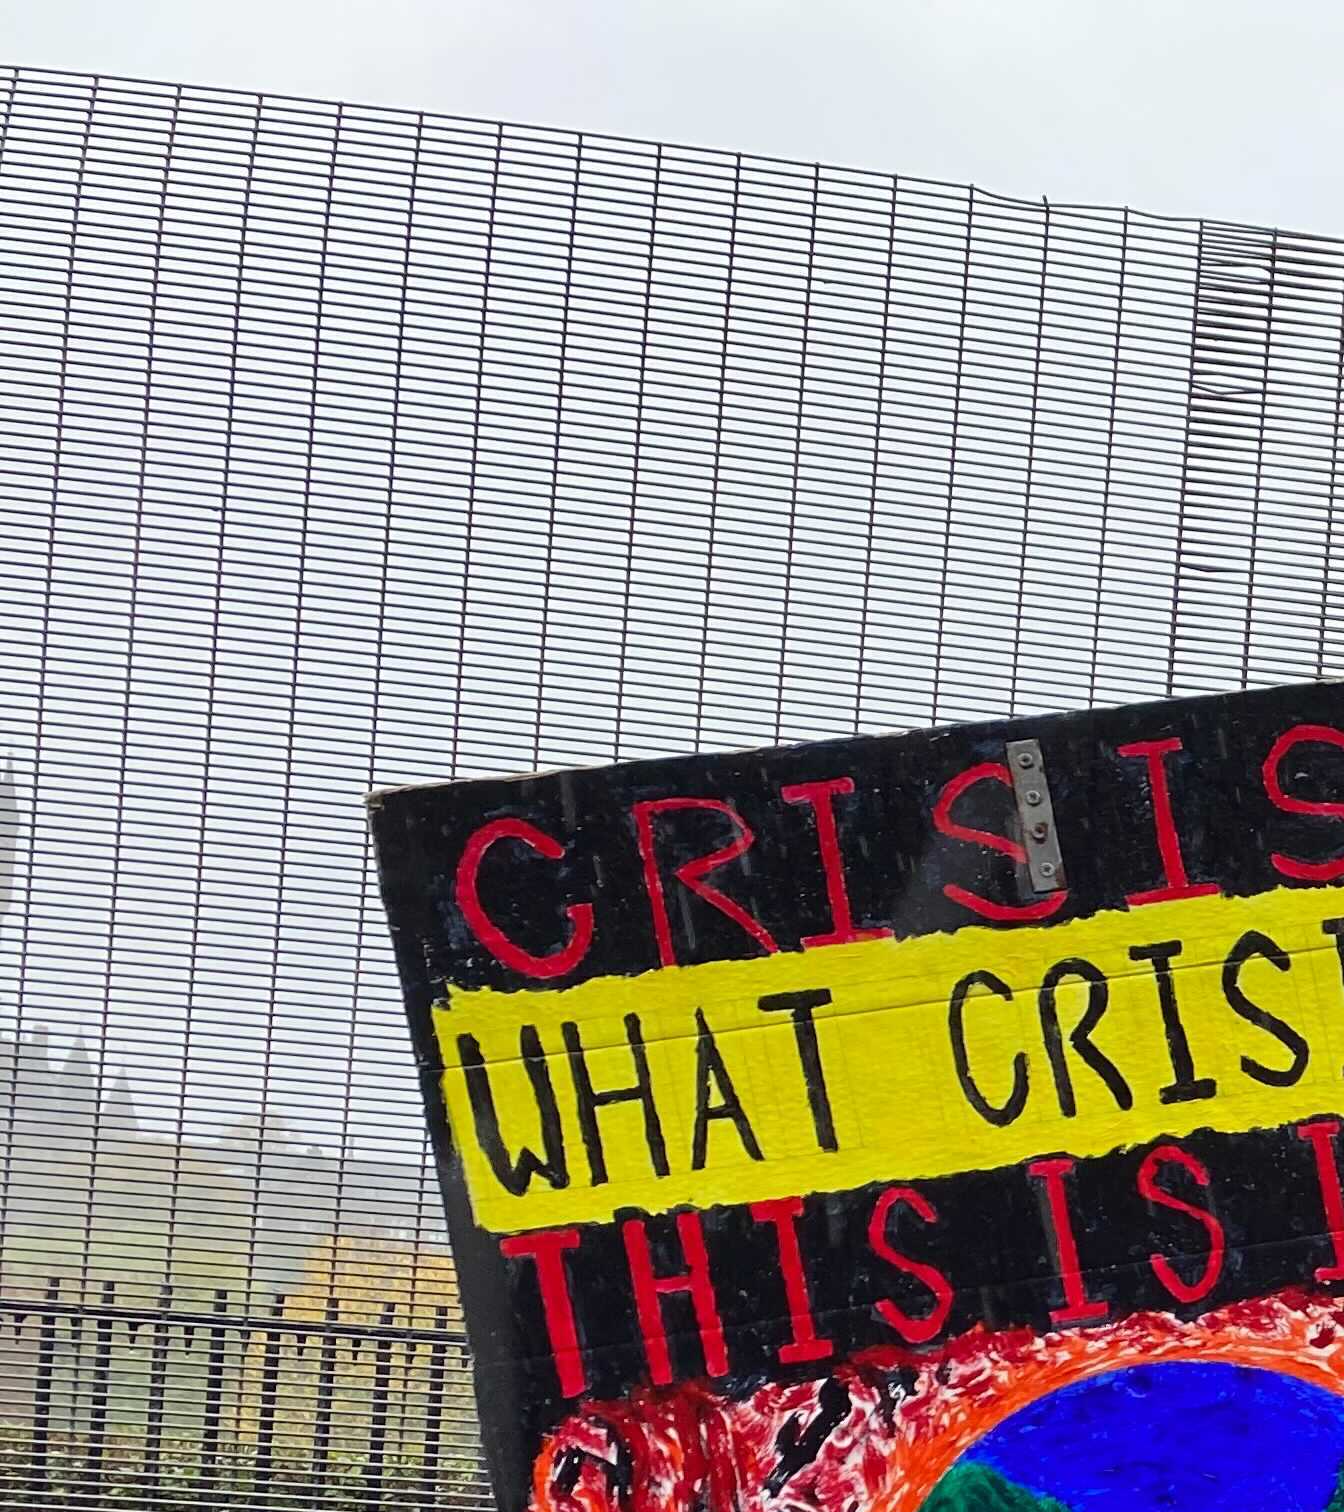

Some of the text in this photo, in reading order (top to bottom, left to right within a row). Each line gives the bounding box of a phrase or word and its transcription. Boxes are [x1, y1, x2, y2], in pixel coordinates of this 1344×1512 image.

[456, 988, 839, 1197] WHAT
[499, 1185, 953, 1400] THIS
[1025, 1145, 1226, 1323] IS
